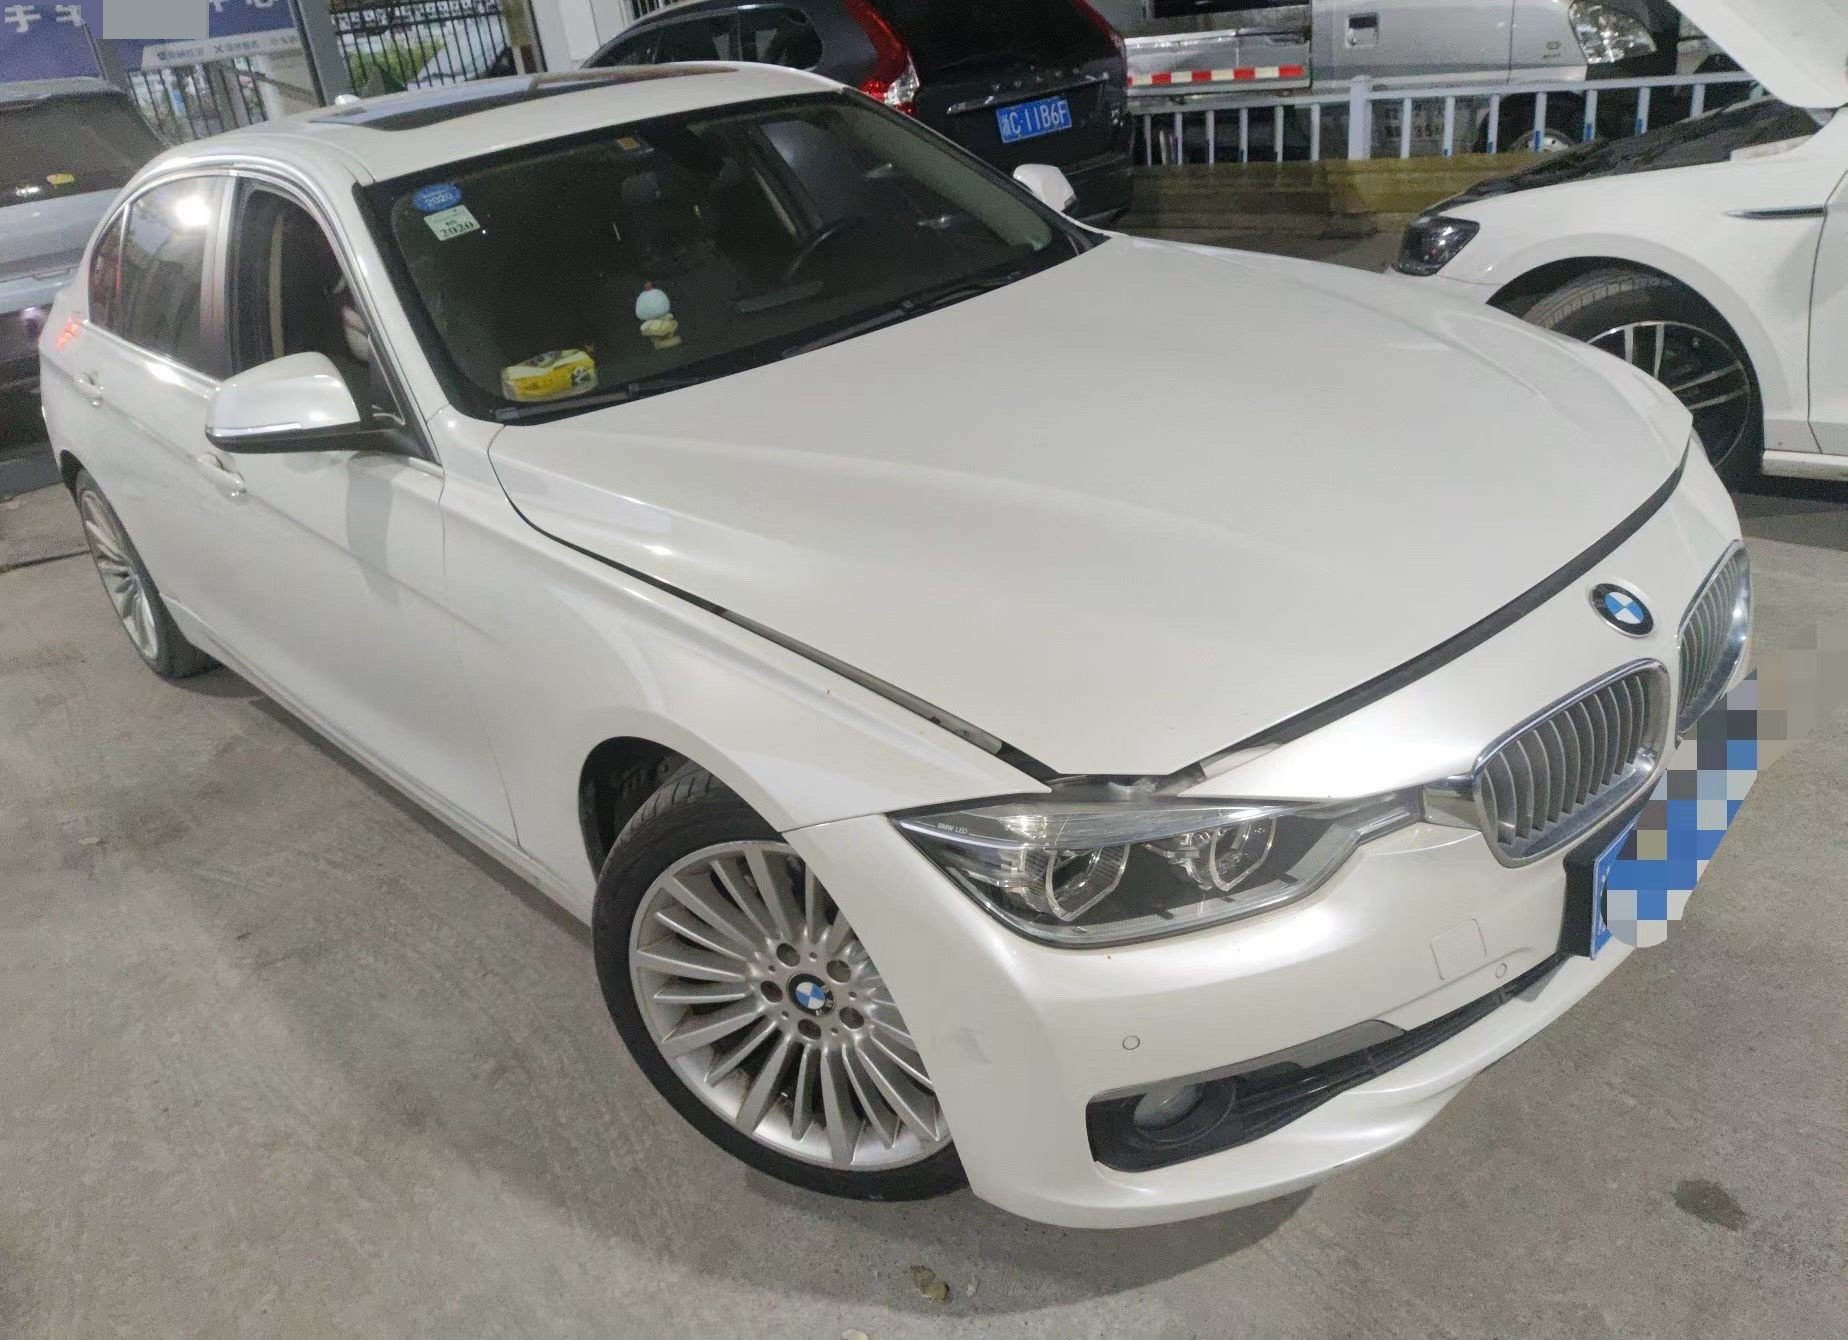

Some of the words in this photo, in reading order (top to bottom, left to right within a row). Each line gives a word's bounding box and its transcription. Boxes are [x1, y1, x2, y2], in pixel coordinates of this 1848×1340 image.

[439, 221, 475, 238] 2020
[937, 822, 955, 832] BMW
[955, 826, 969, 834] LED
